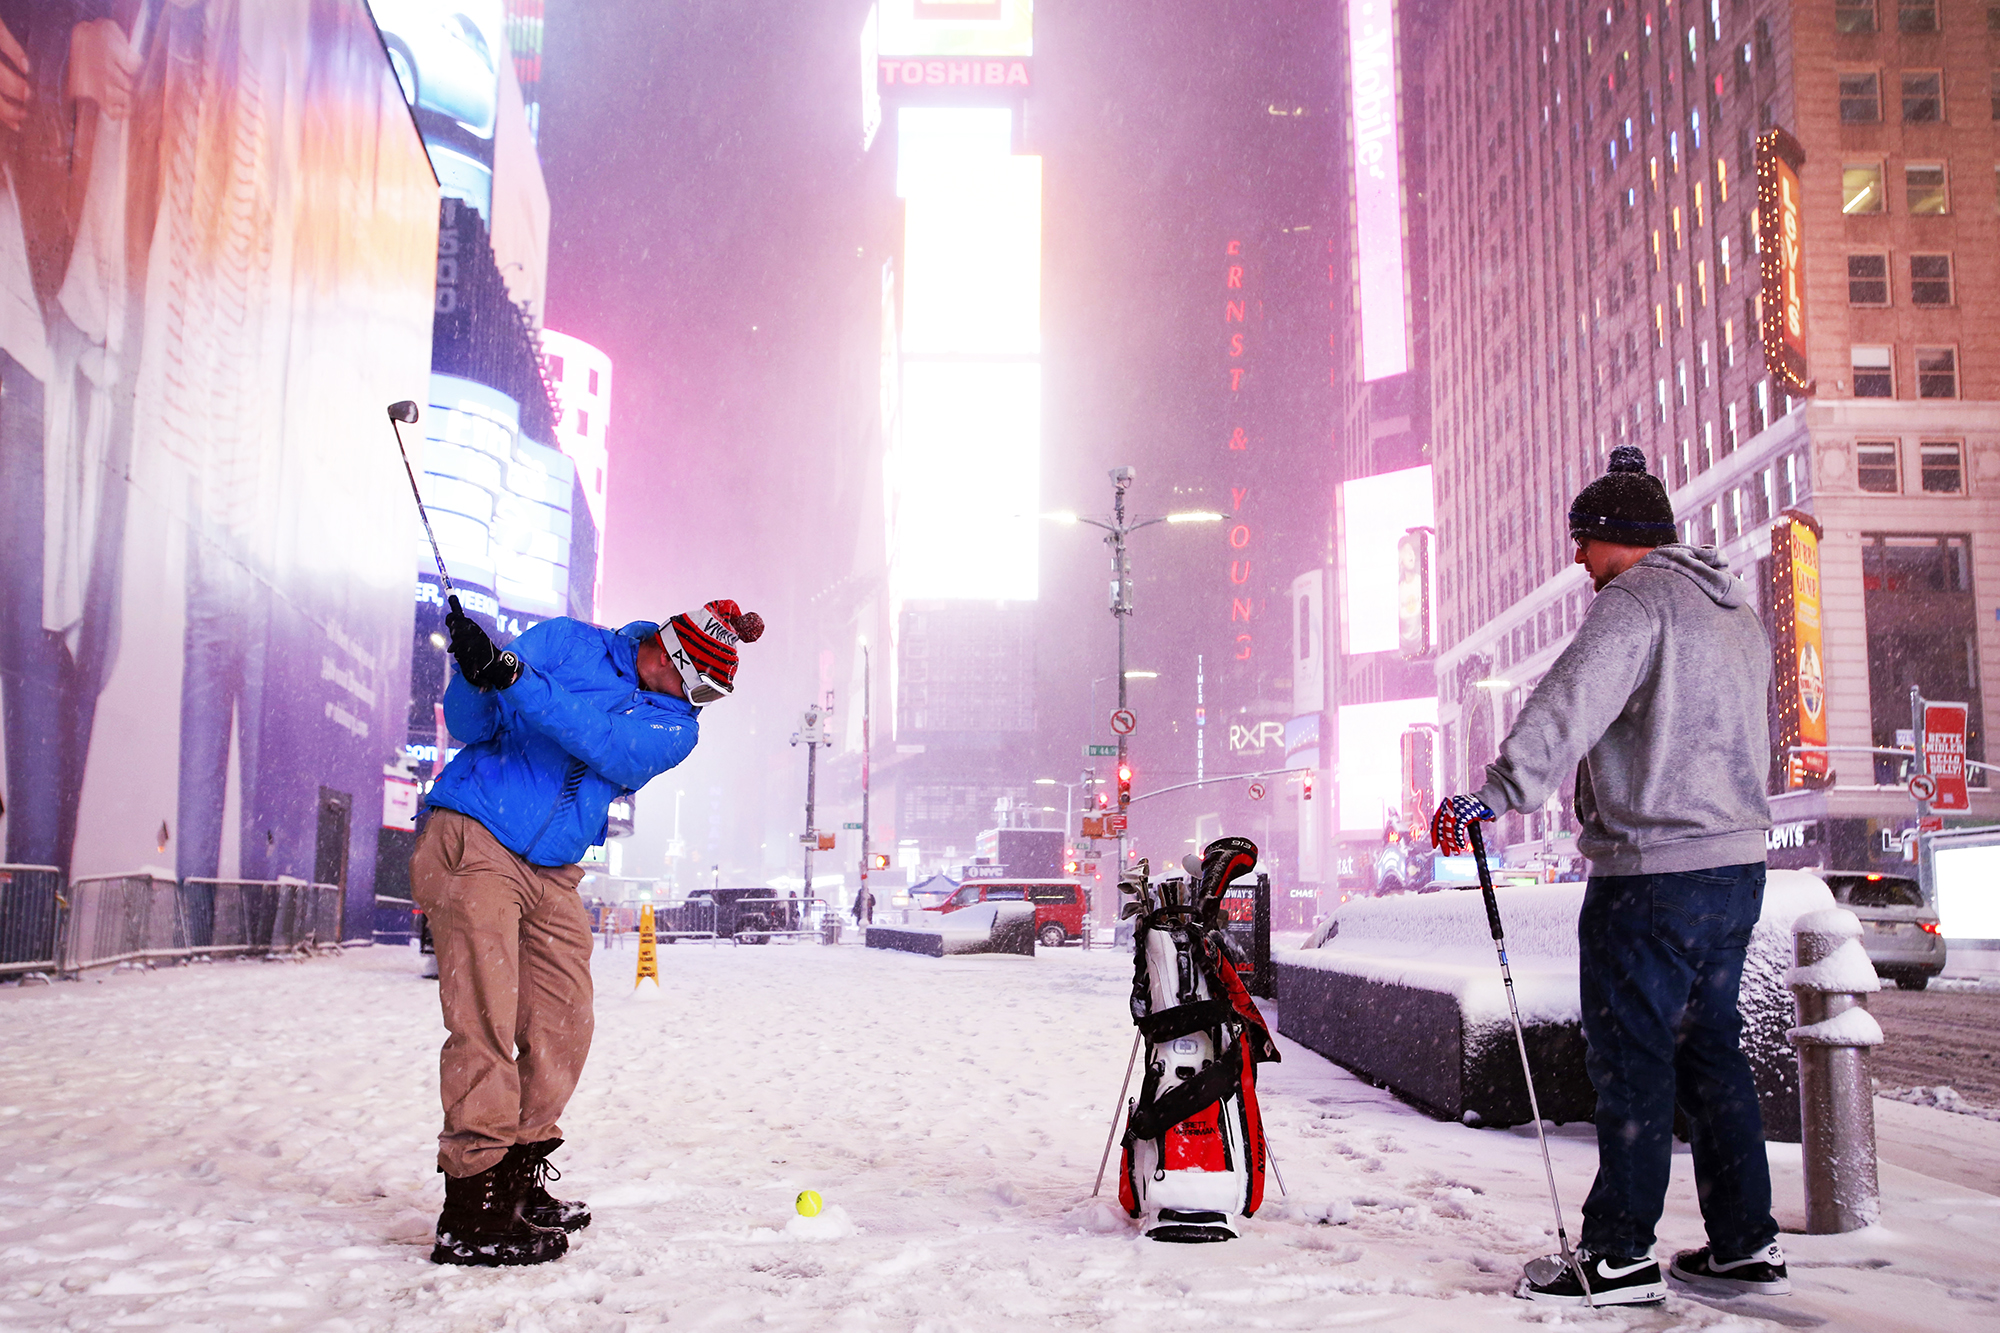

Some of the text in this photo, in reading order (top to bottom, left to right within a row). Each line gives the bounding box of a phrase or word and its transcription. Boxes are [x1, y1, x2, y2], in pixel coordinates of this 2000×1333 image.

[879, 61, 1030, 85] TOSHIBA
[1228, 427, 1248, 450] &
[1229, 721, 1285, 751] RXR
[1928, 732, 1962, 743] BETTE
[1926, 743, 1963, 753] MIDLER
[979, 867, 1004, 878] NYC
[1223, 889, 1253, 899] DWAY'S
[1220, 898, 1253, 911] URE
